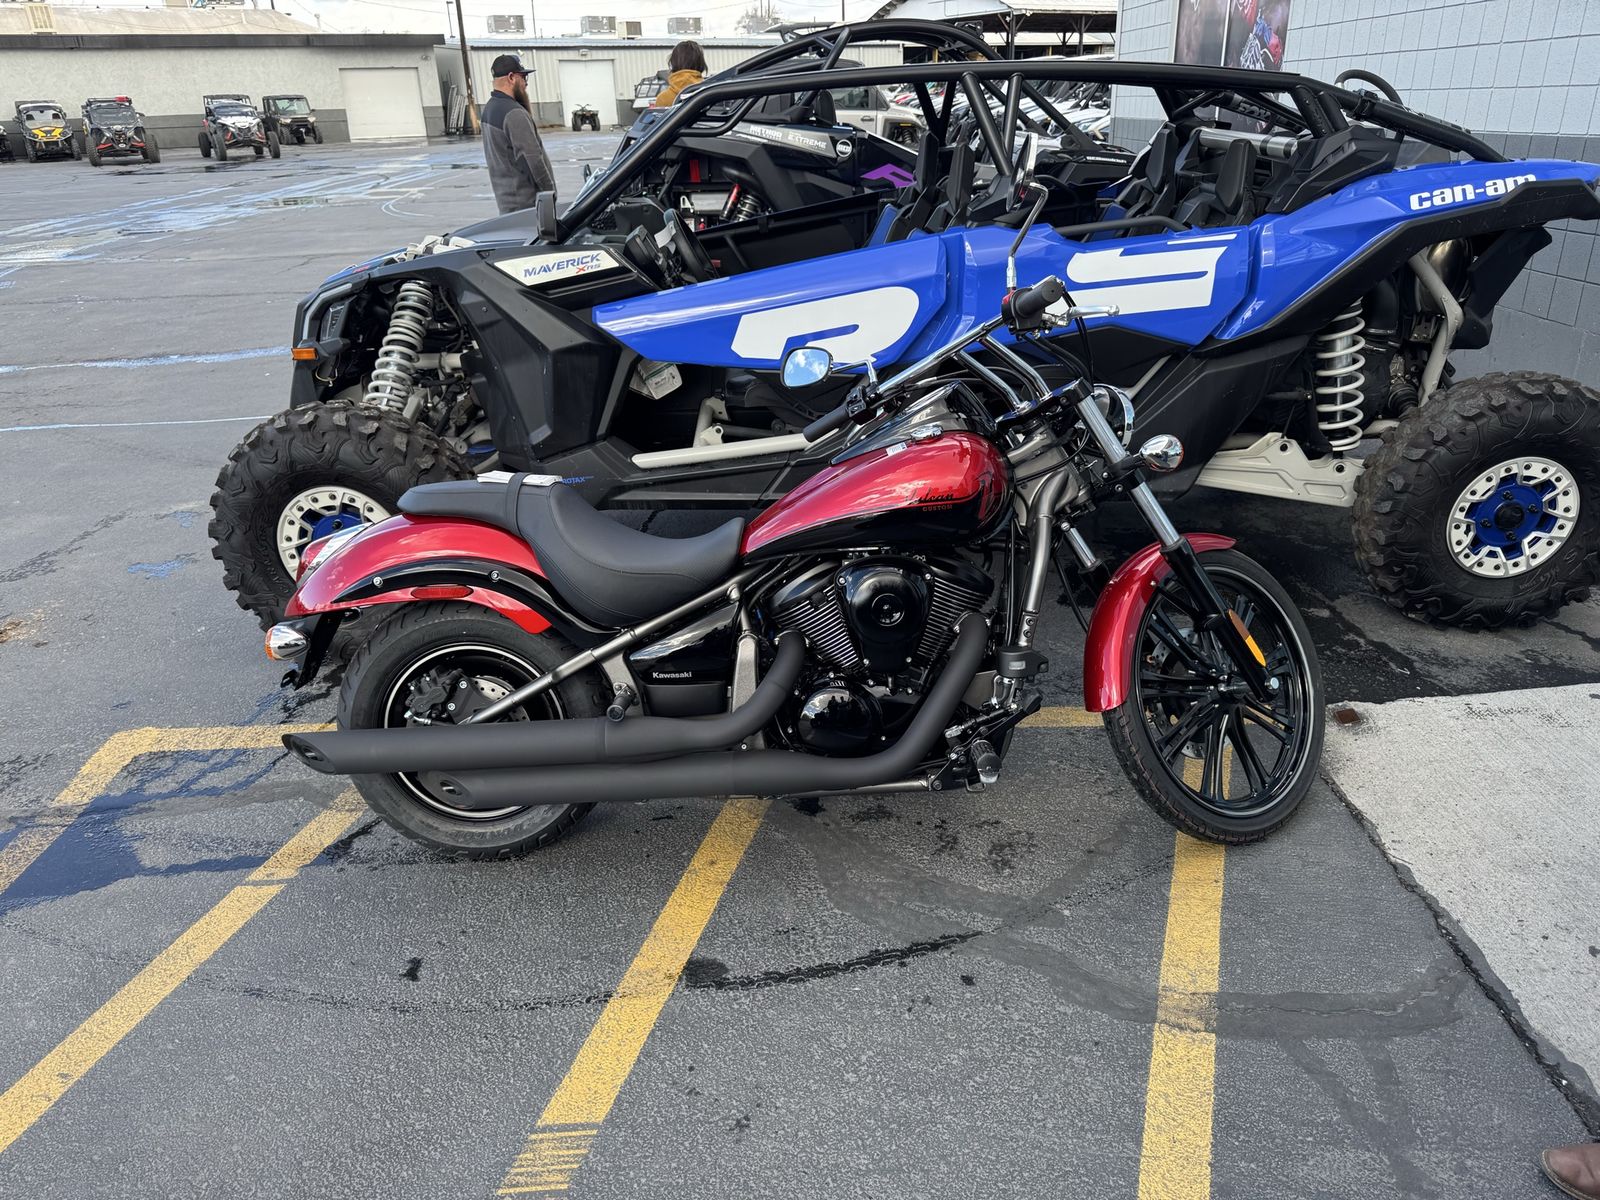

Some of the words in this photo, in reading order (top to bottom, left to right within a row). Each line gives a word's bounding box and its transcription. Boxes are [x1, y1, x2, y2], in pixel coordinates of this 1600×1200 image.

[523, 252, 601, 278] MAVERICK
[922, 504, 953, 512] CUSTOM
[652, 671, 692, 679] Kawasaki
